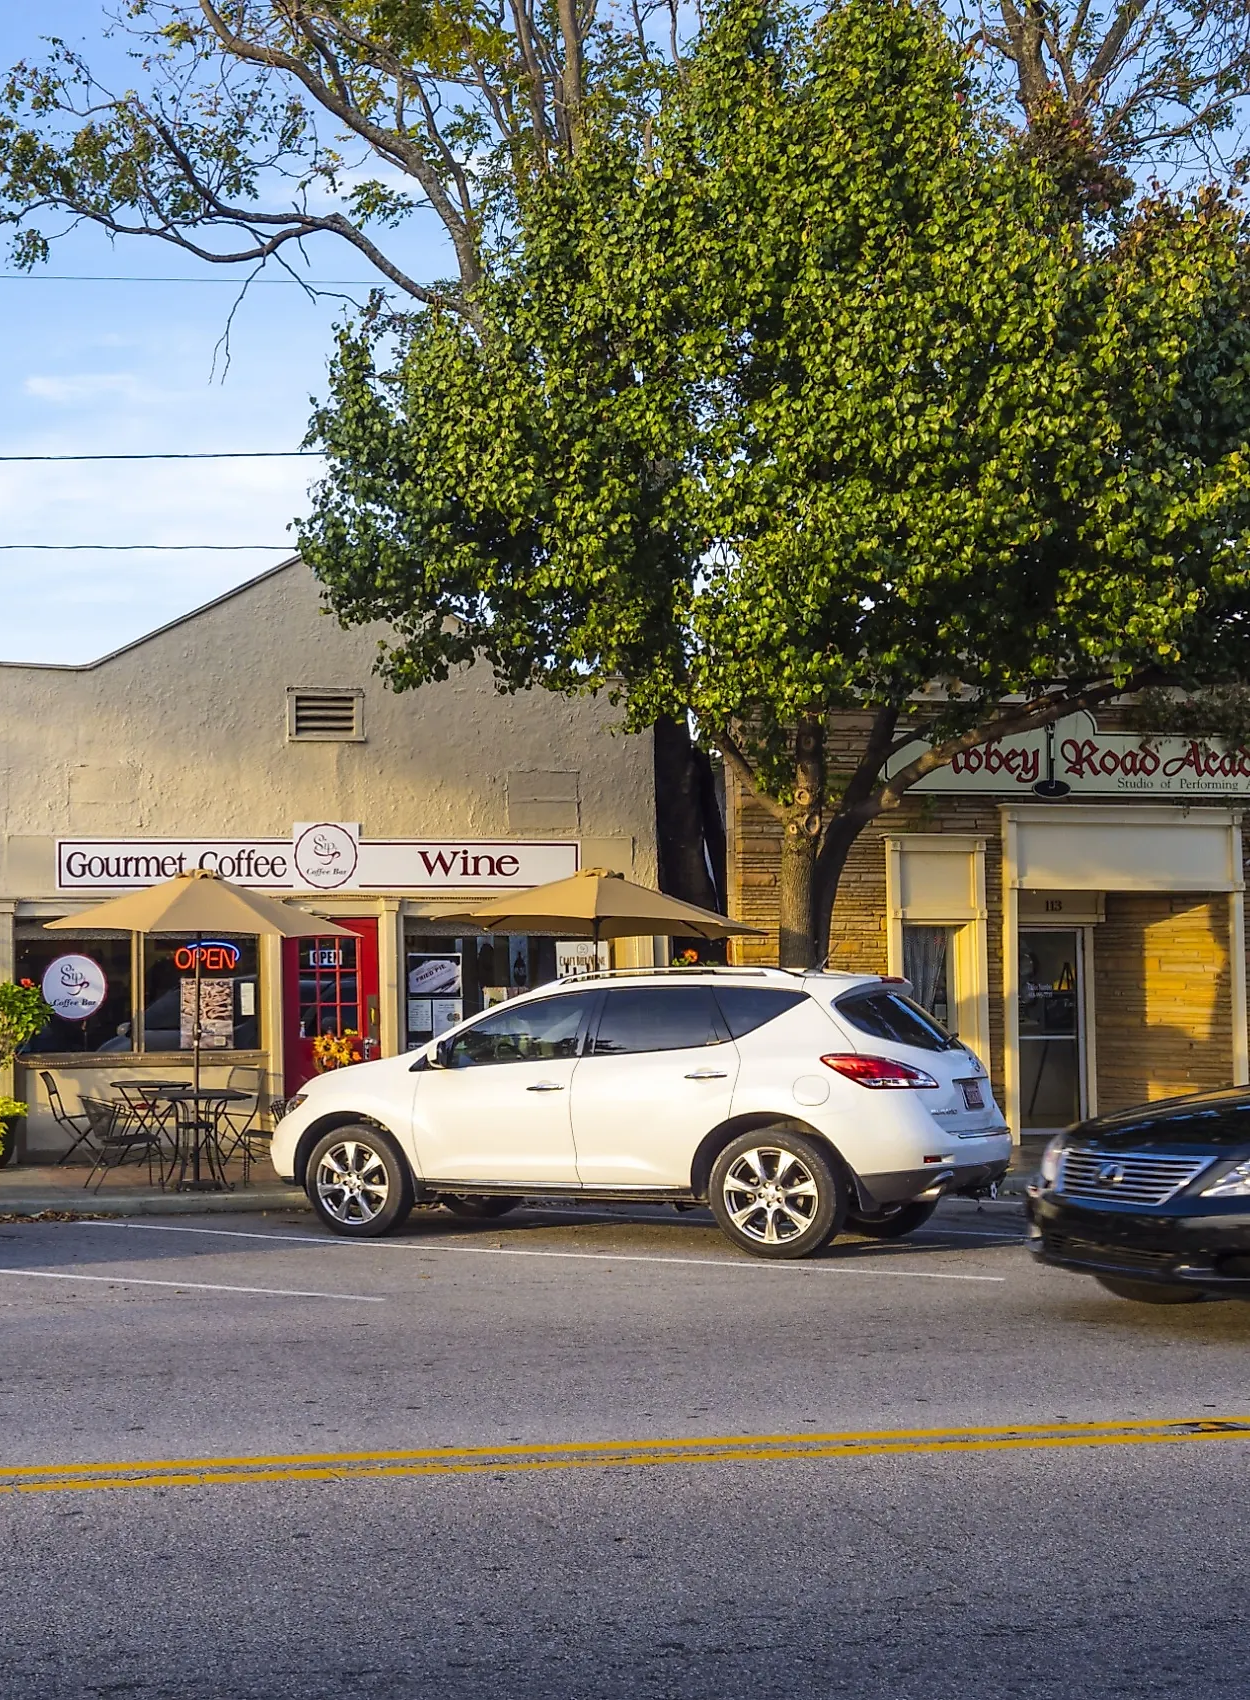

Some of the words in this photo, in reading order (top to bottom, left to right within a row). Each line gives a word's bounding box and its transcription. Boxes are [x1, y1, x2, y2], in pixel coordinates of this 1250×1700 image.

[1061, 739, 1160, 778] Road
[1117, 777, 1154, 789] Studio
[1160, 778, 1171, 789] of
[1180, 779, 1239, 791] Performing
[66, 851, 187, 878] Gourmet
[198, 849, 287, 878] Coffee
[306, 868, 330, 877] Coffee
[418, 849, 519, 877] Wine
[1045, 900, 1062, 912] 113
[175, 948, 235, 969] OPEN
[60, 964, 85, 984] Sip
[53, 999, 78, 1008] Coffee
